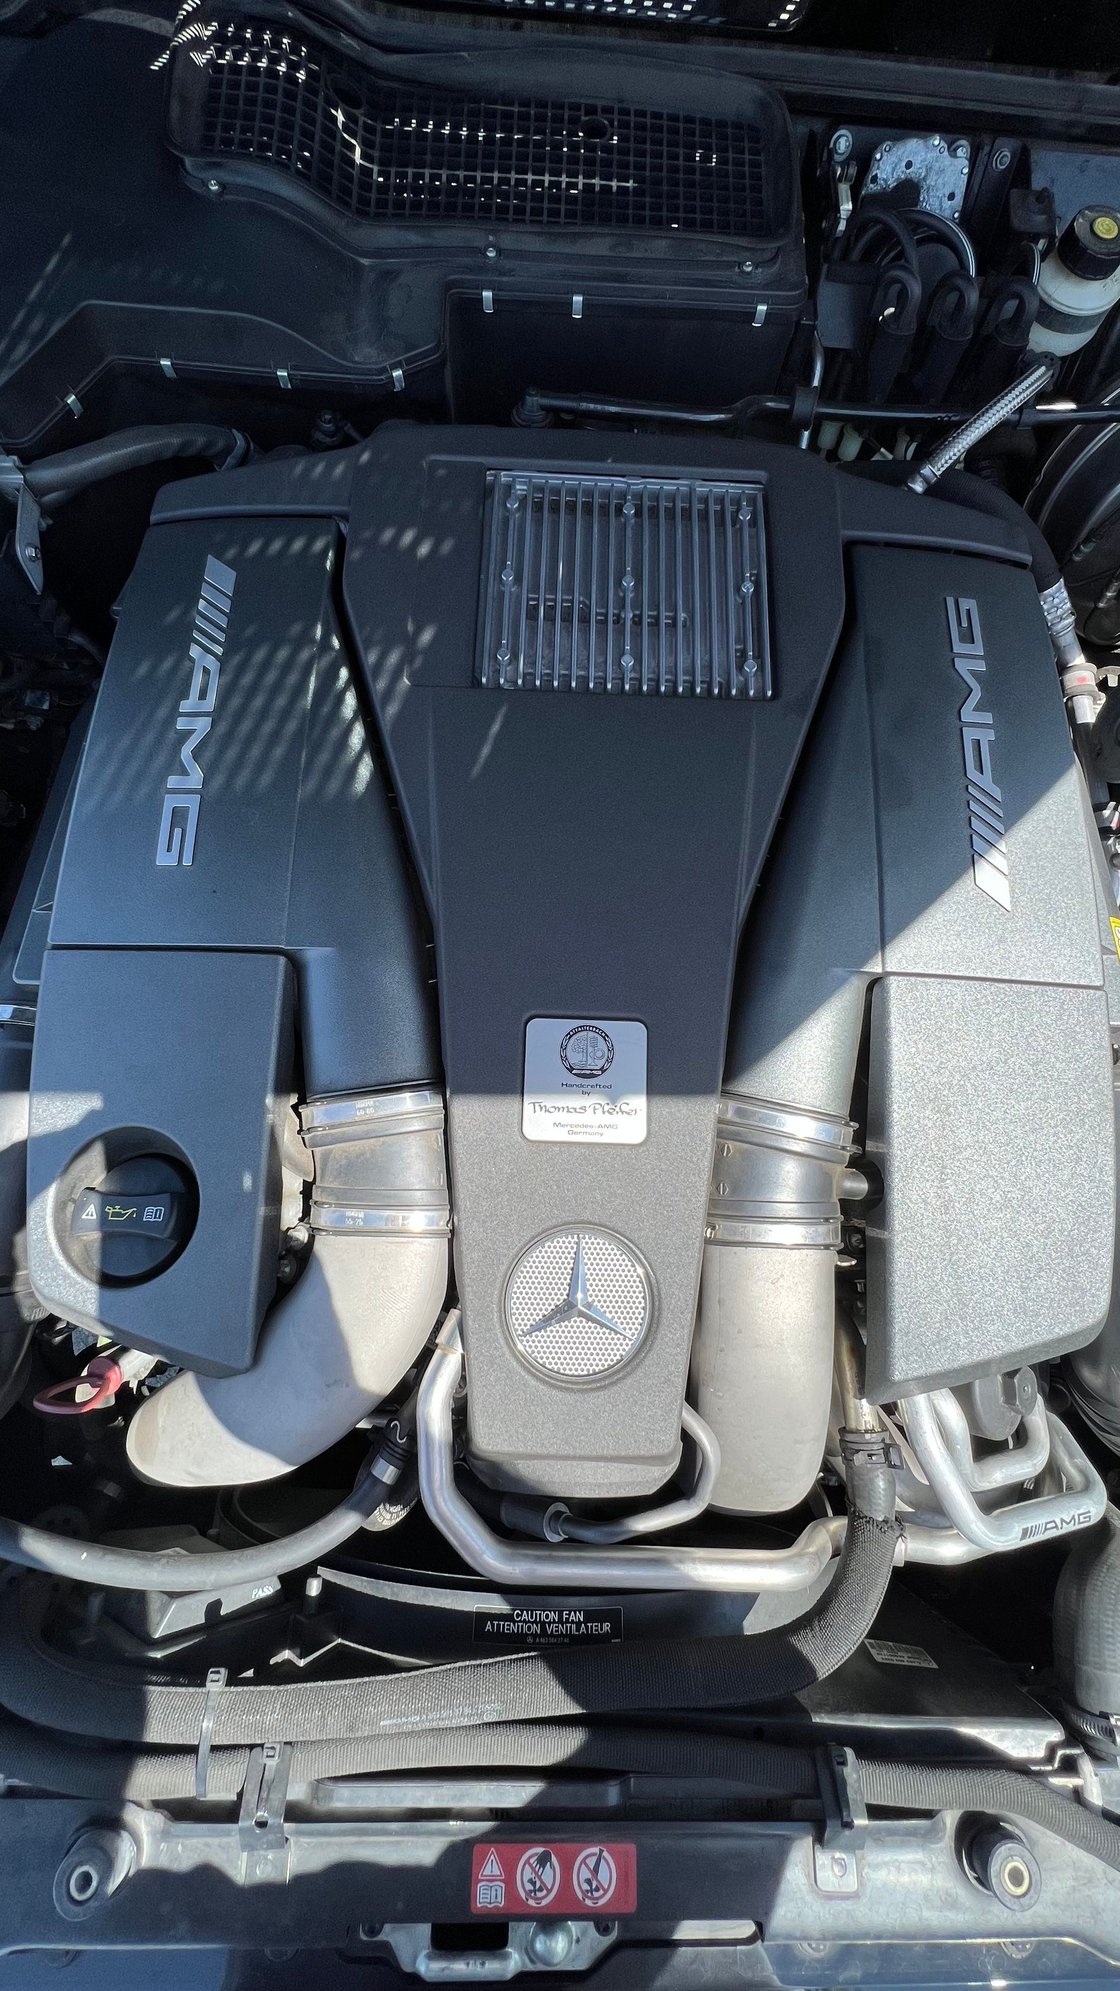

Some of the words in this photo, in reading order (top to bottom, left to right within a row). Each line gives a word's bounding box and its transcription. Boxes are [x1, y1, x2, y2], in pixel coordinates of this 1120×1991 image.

[946, 596, 1002, 802] AMG
[156, 642, 221, 867] AMG
[528, 1101, 587, 1114] Thomas
[567, 1129, 604, 1137] Germany
[1042, 1510, 1092, 1535] AMG
[513, 1609, 558, 1622] CAUTION
[562, 1610, 584, 1622] FAN
[485, 1621, 541, 1634] ATTENTION
[545, 1622, 611, 1635] VENTILATEUR
